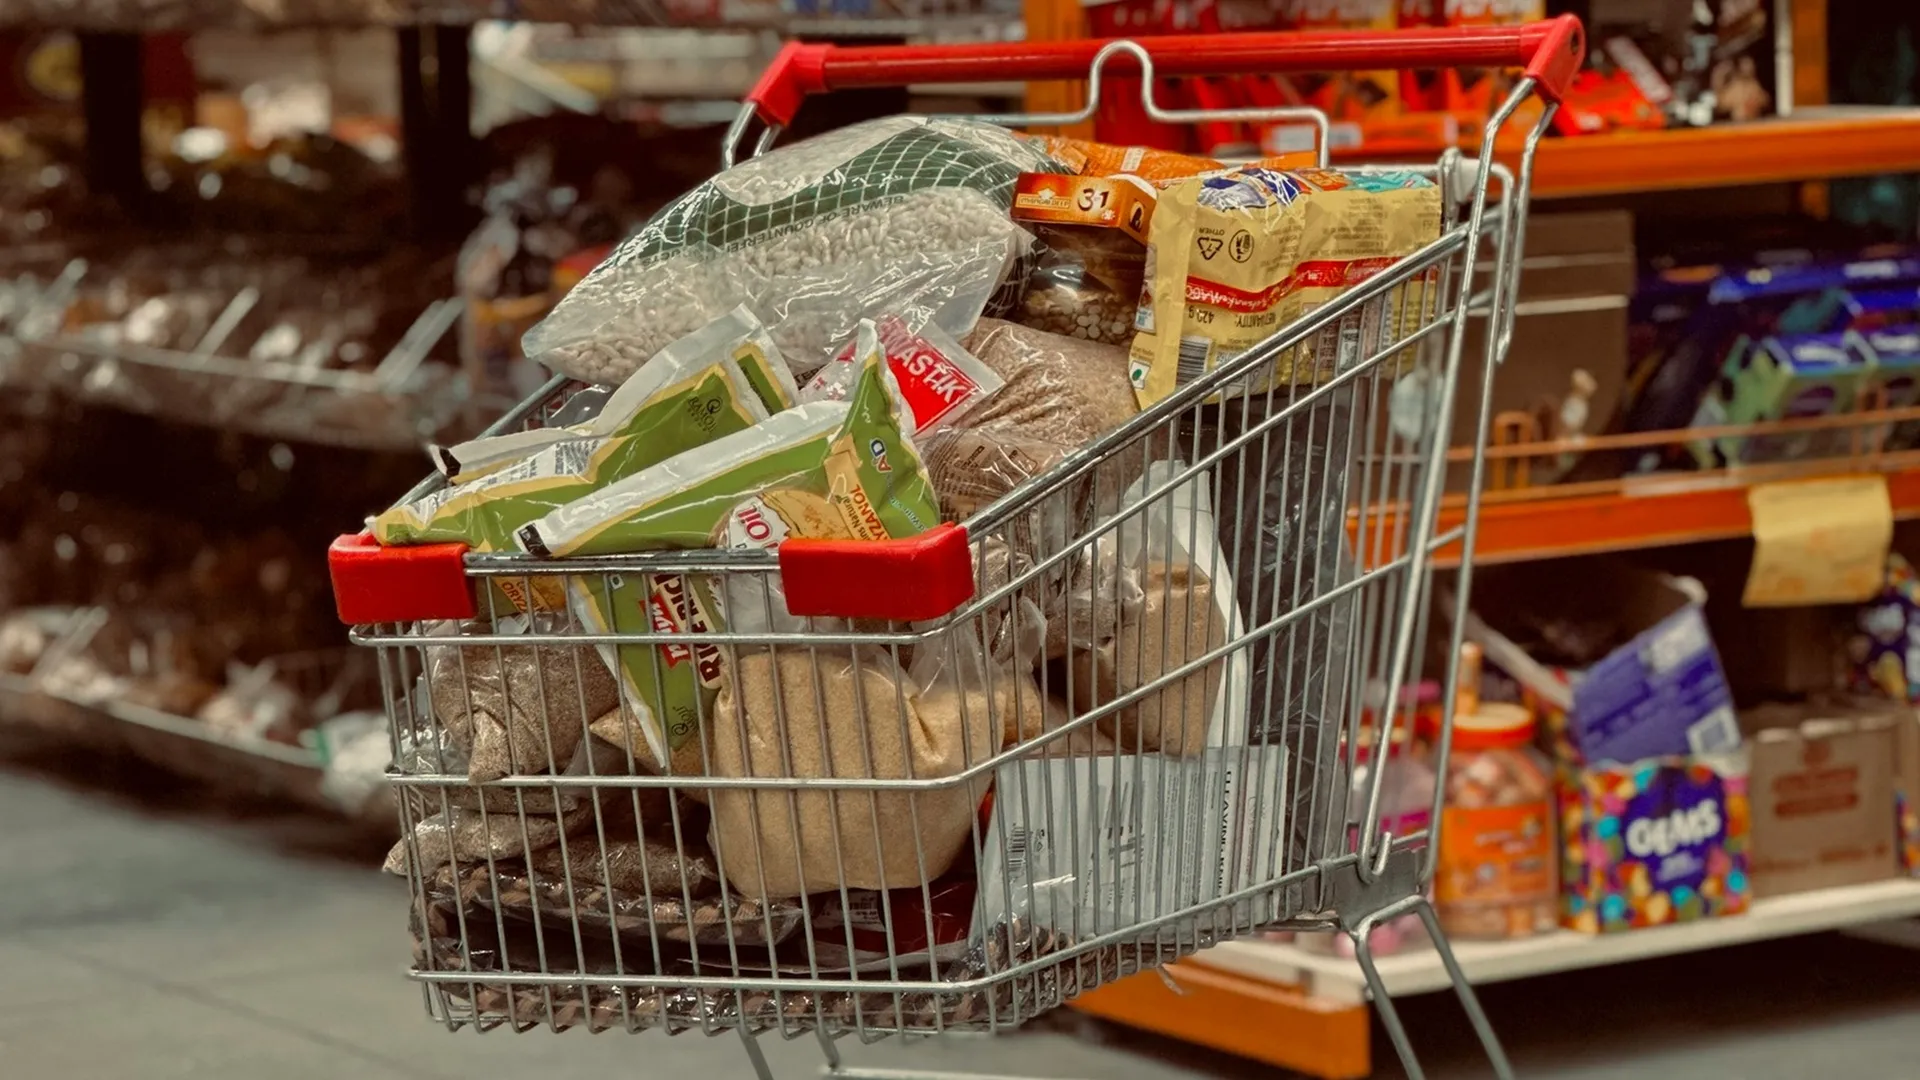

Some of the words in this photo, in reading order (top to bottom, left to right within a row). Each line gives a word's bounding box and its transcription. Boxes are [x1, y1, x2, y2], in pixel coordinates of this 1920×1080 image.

[816, 212, 838, 226] OF
[841, 195, 905, 219] BEWARE
[726, 219, 814, 253] COUNTERFEI
[1199, 228, 1225, 237] OTHER
[737, 506, 771, 541] Oil
[849, 484, 889, 541] YZANOL
[1626, 797, 1721, 858] GEMS
